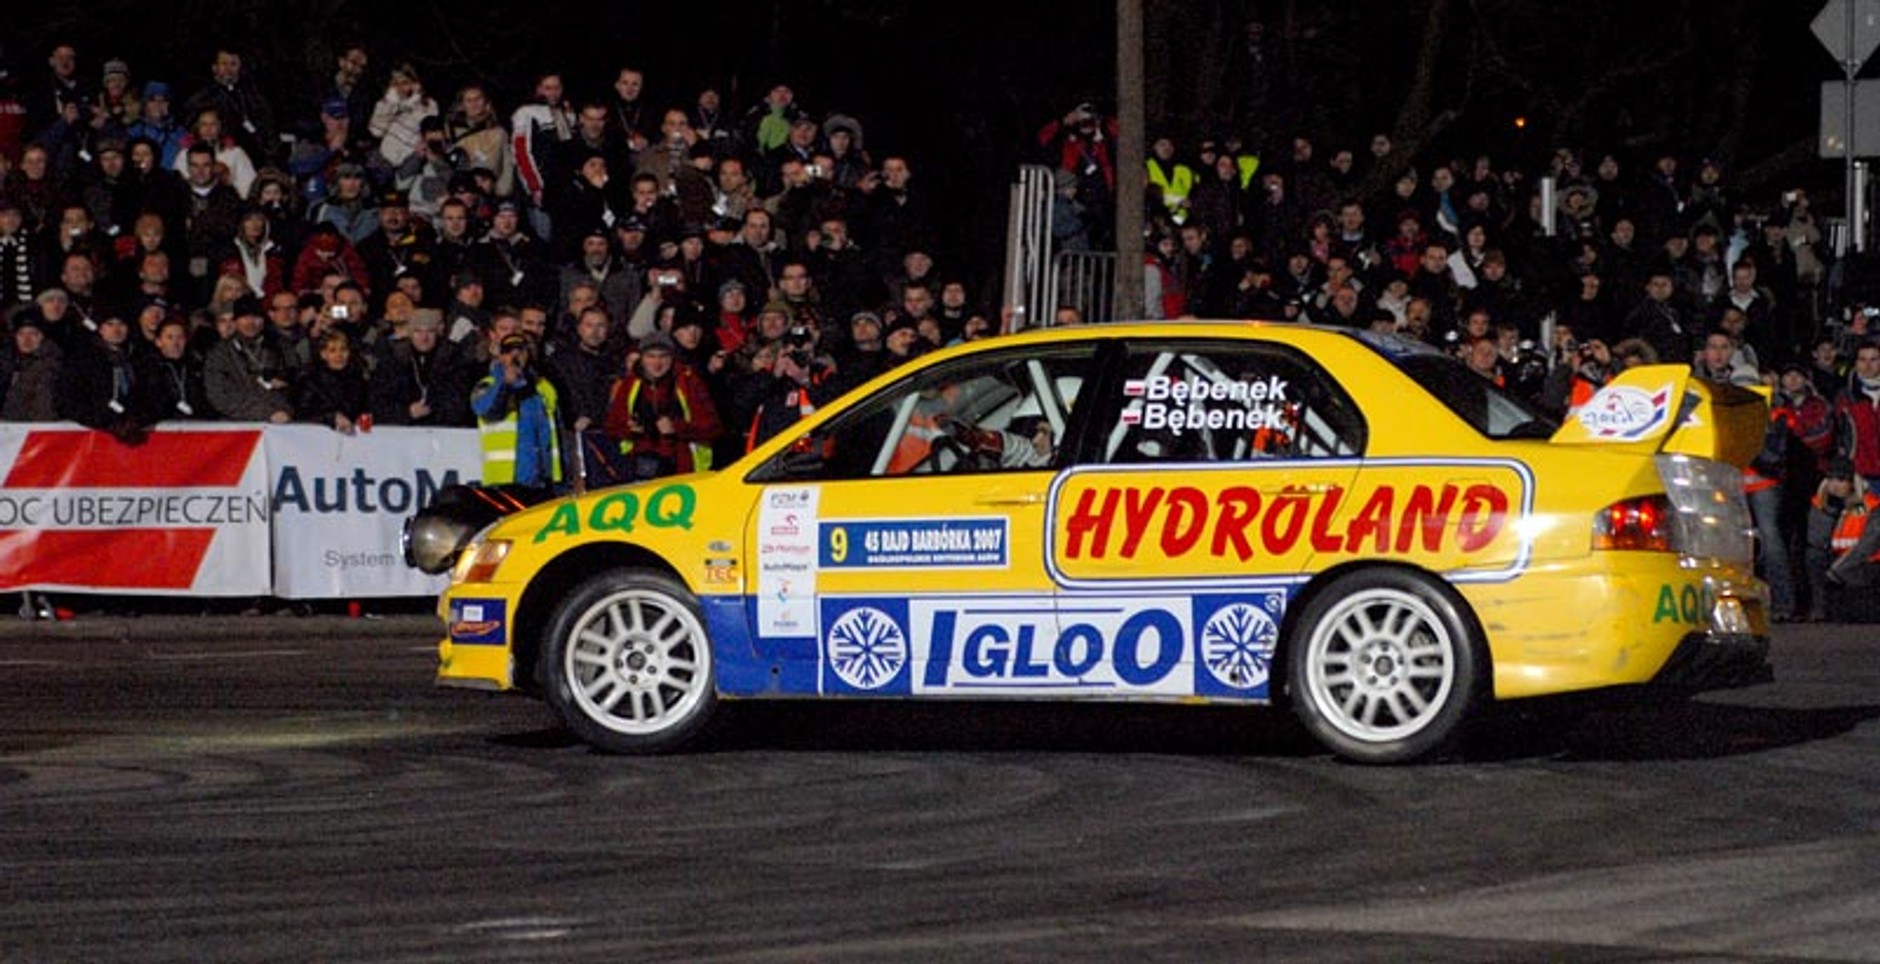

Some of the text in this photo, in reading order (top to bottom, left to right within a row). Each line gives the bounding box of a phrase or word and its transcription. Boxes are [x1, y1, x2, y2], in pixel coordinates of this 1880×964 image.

[1147, 376, 1288, 406] Bębenek
[1143, 403, 1284, 435] Bębenek
[270, 465, 482, 514] AutoM
[53, 490, 269, 526] UBEZPIECZEŃ
[533, 483, 696, 543] AQQ
[1065, 485, 1509, 561] HYDROLAND
[830, 527, 848, 562] 9
[865, 523, 1003, 551] 45 RAJD BARBÓRKA 2007
[325, 550, 395, 569] System
[923, 608, 1184, 687] IGLOO
